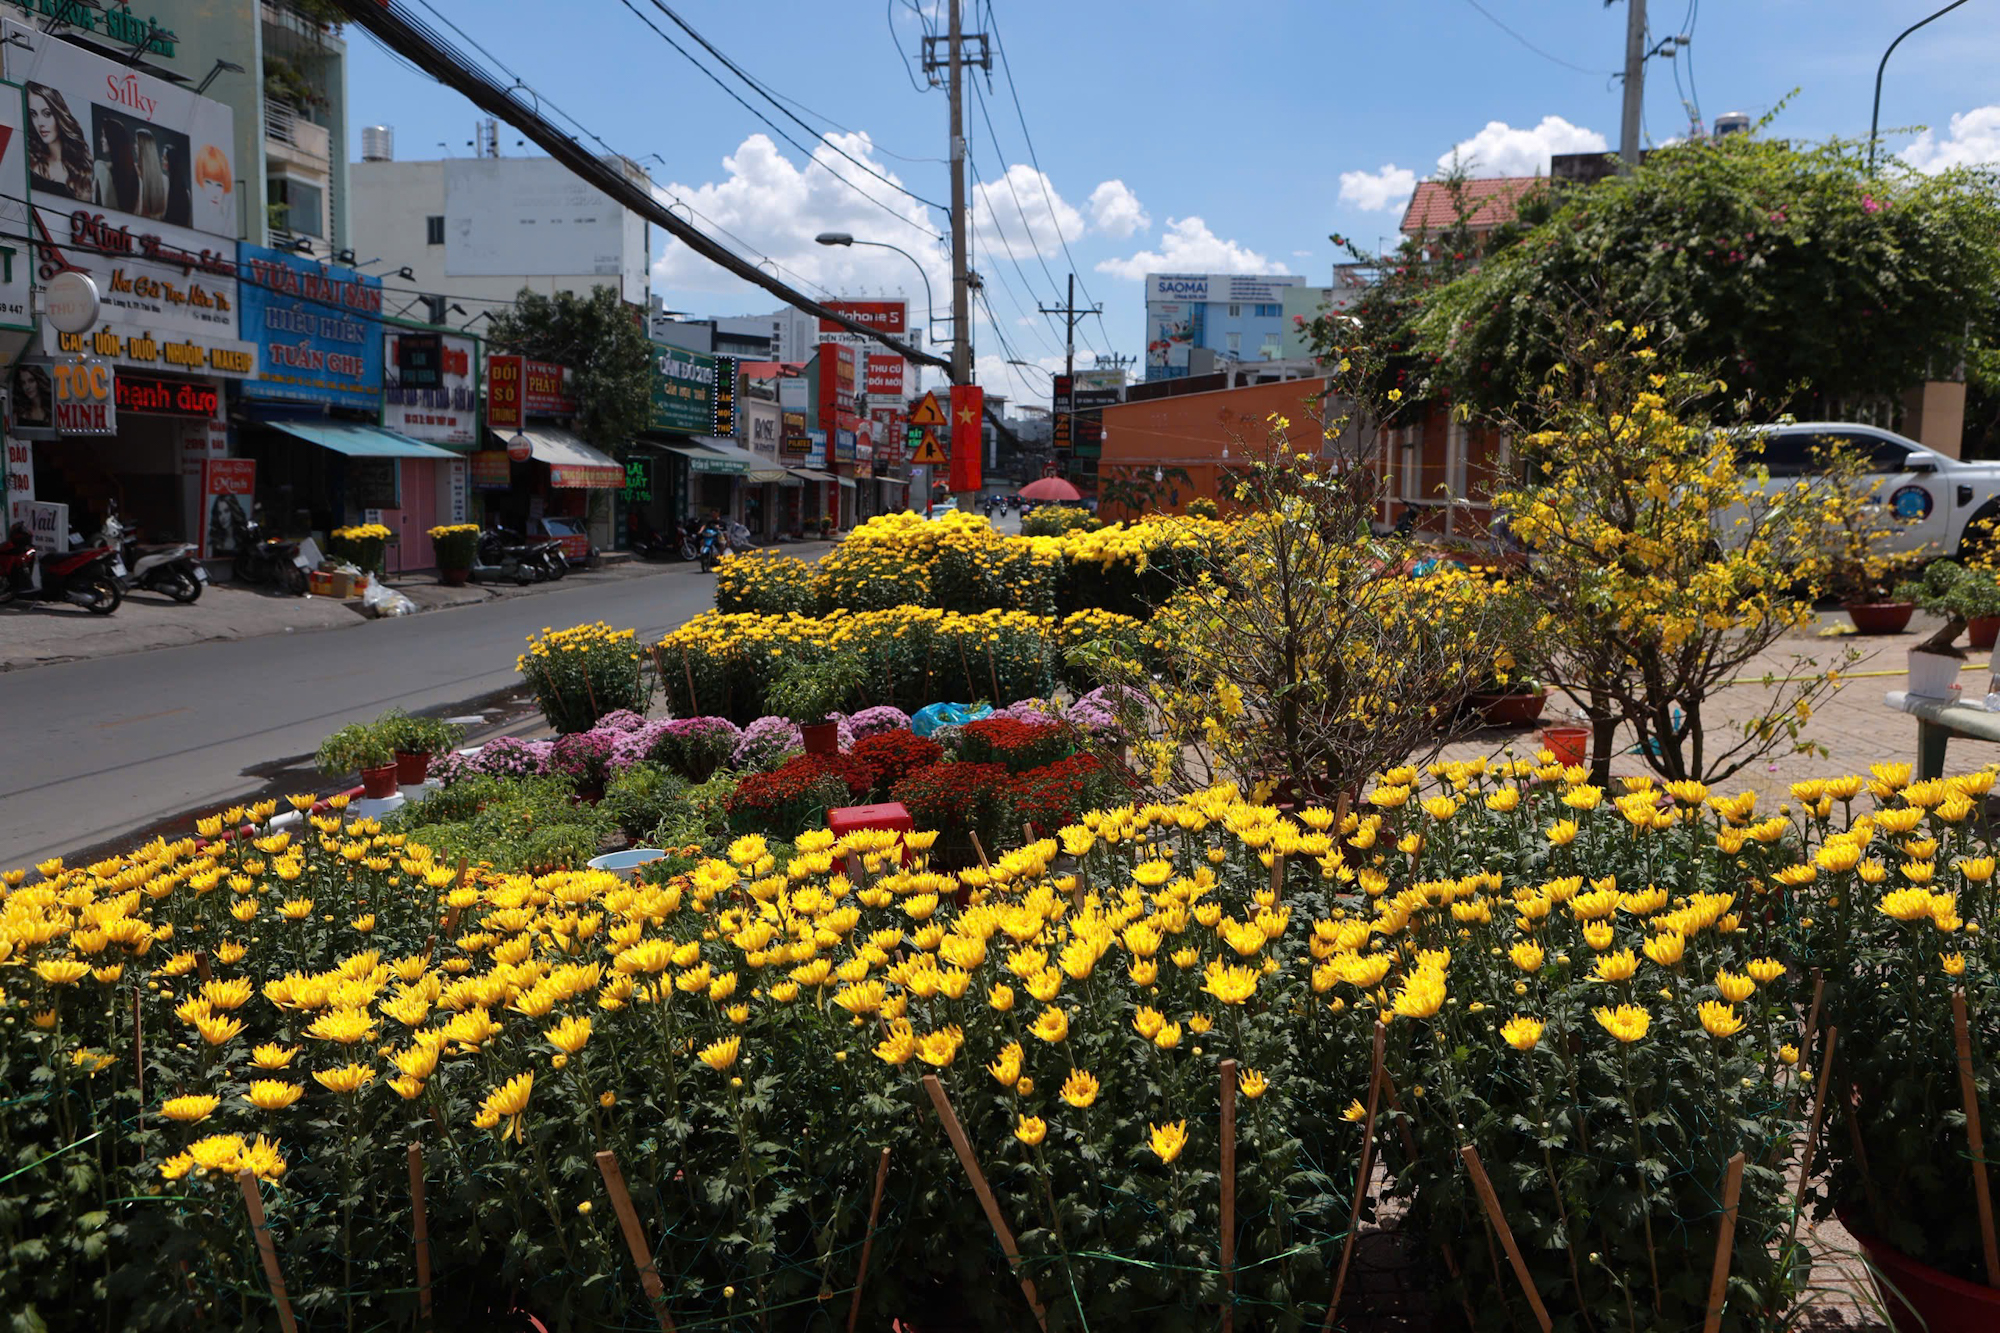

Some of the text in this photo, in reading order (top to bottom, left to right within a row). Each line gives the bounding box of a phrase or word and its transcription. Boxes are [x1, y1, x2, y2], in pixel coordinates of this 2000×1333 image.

[106, 74, 158, 120] Silky
[70, 210, 132, 257] Minh
[250, 258, 383, 313] VỰA HẢI SẢN
[54, 354, 107, 399] TÓC
[211, 348, 253, 373] MAKEUP
[869, 362, 901, 374] THU CŨ
[56, 404, 107, 428] MINH
[28, 508, 58, 532] Nail
